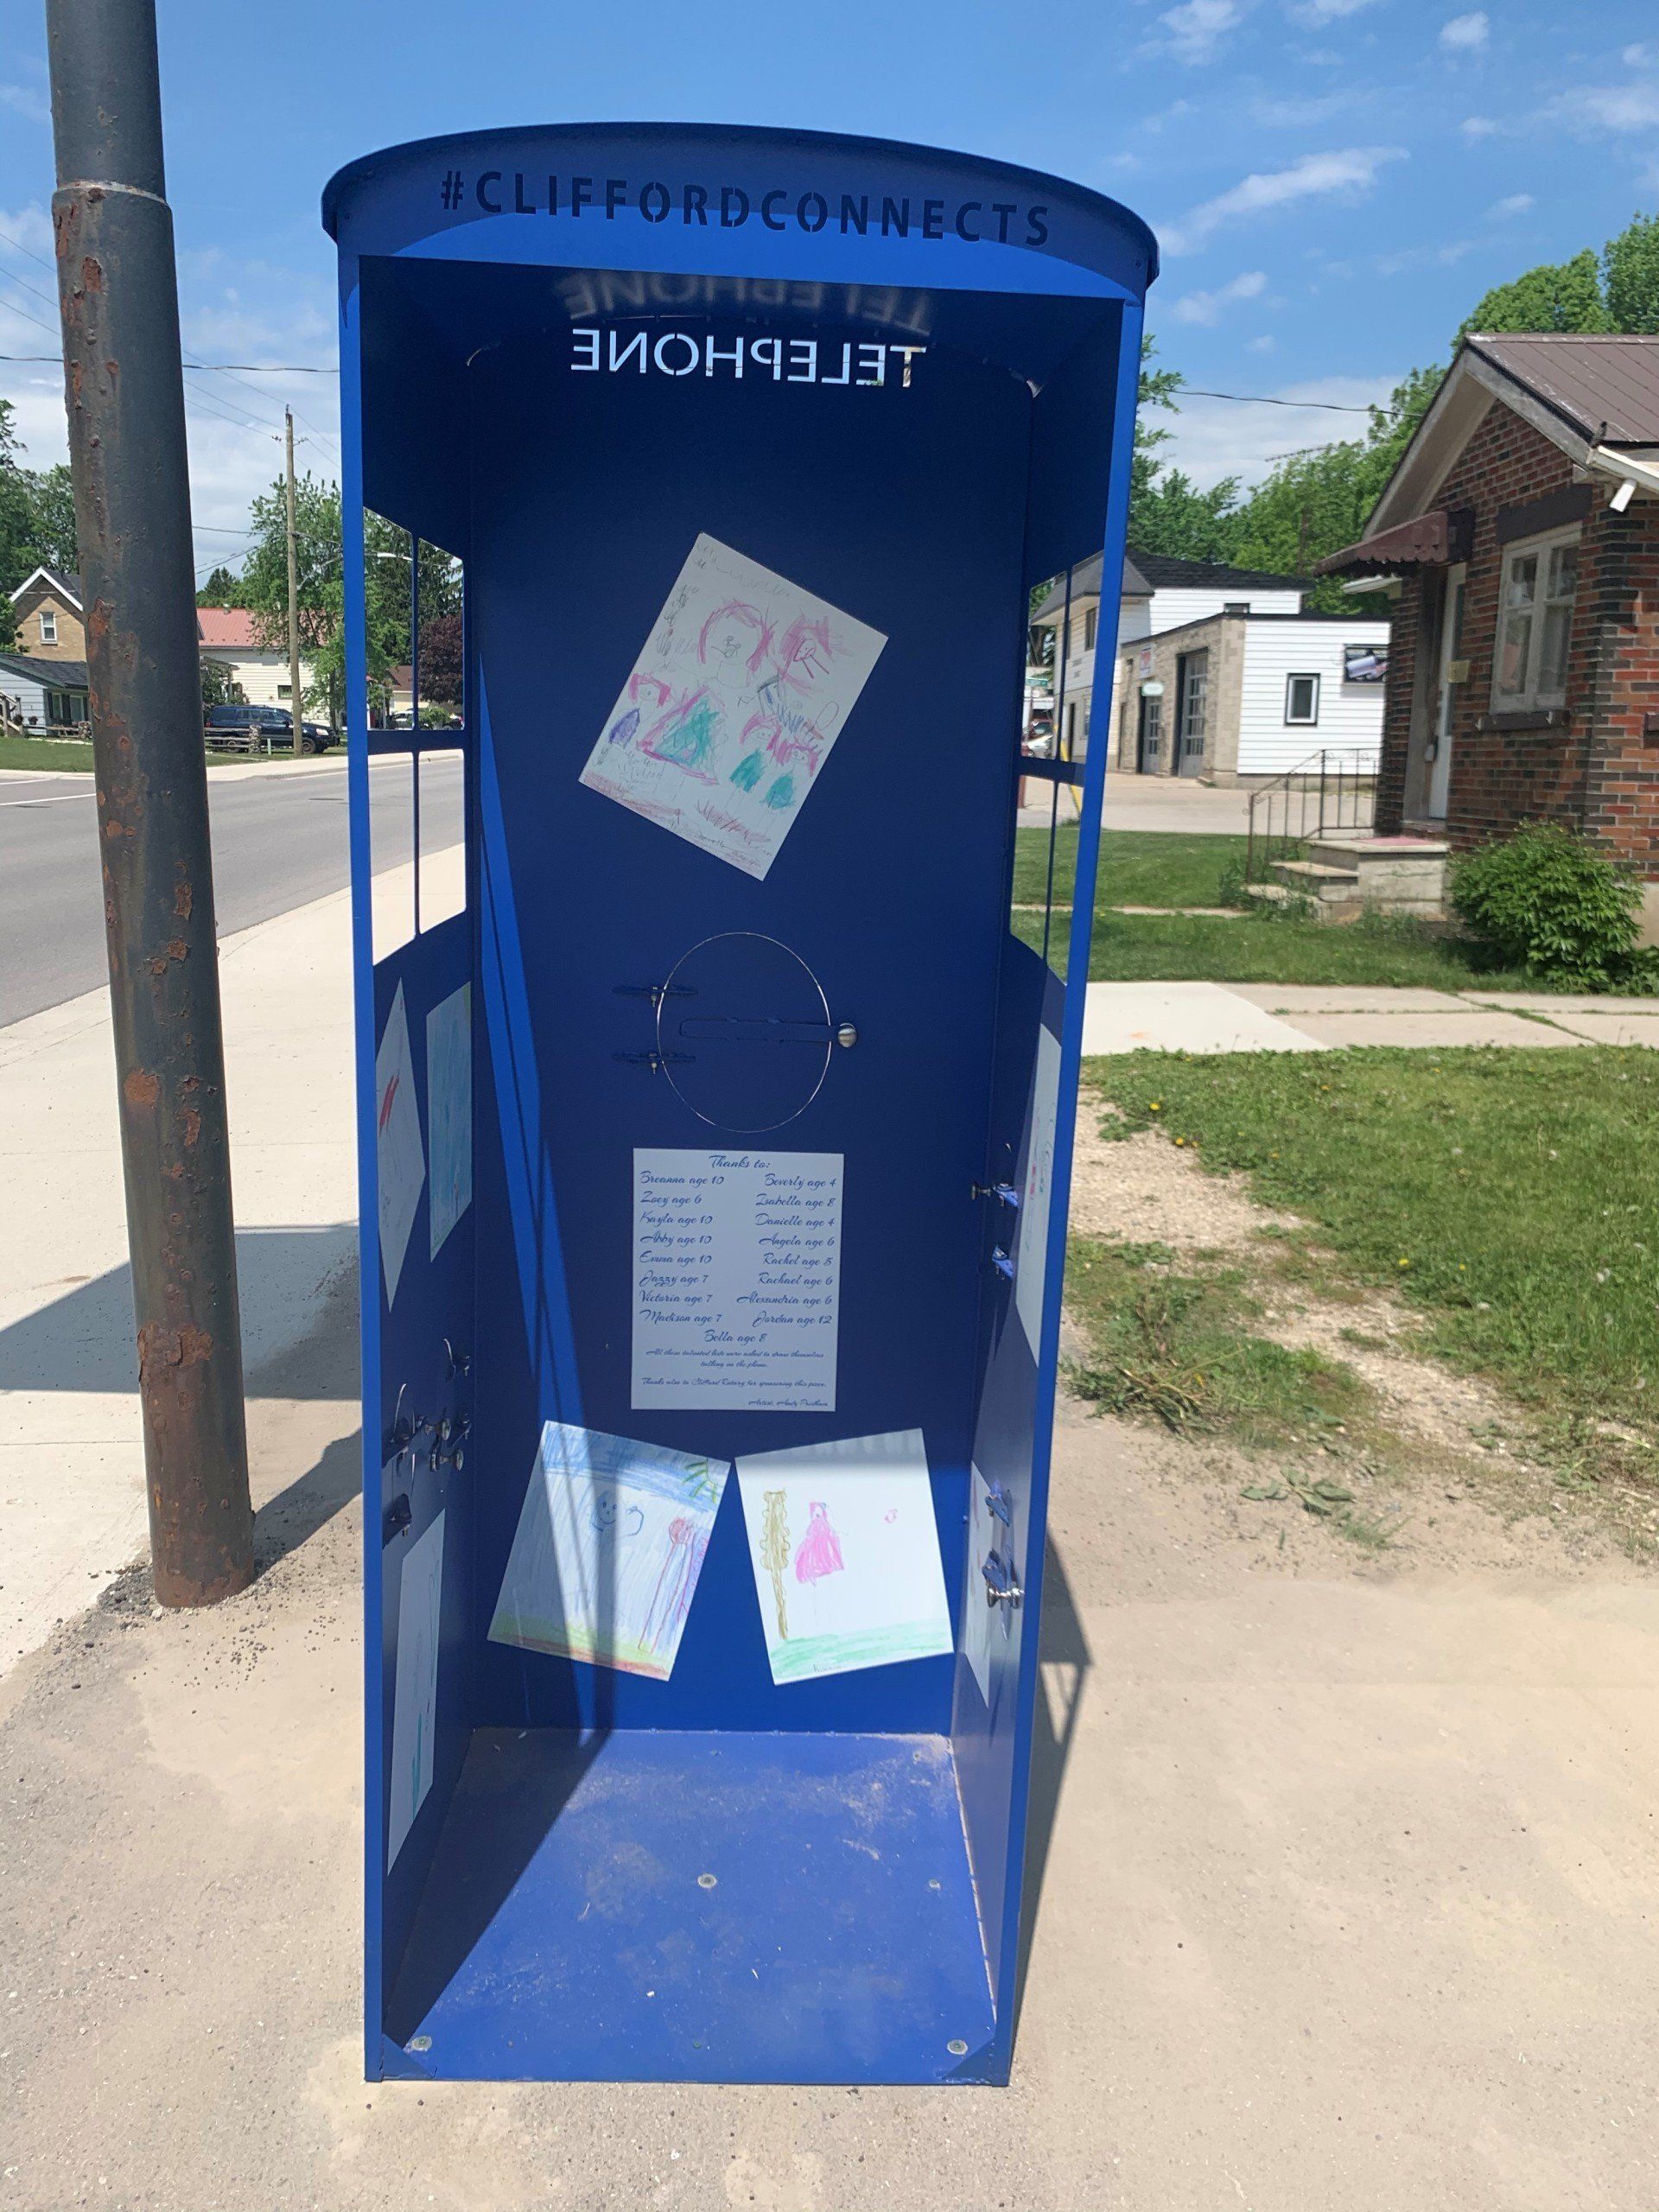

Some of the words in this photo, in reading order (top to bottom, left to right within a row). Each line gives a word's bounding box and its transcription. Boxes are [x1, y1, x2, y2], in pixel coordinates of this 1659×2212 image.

[441, 170, 1051, 247] #CLIFFORDCONNECTS
[708, 1155, 750, 1168] Thanks
[753, 1159, 770, 1168] to:
[640, 1171, 685, 1184] Breanna
[689, 1177, 708, 1188] age
[711, 1176, 724, 1185] 10
[765, 1173, 804, 1189] Beverly
[807, 1179, 826, 1191] age
[830, 1179, 836, 1188] 4
[640, 1191, 670, 1207] Zoey
[671, 1197, 691, 1208] age
[694, 1194, 702, 1204] 6
[755, 1193, 803, 1206] Isabella
[805, 1199, 824, 1211] age
[827, 1198, 836, 1207] 8
[639, 1211, 675, 1227] Kayla
[677, 1217, 697, 1228] age
[700, 1216, 713, 1224] 10
[754, 1213, 803, 1226] Danielle
[805, 1219, 825, 1232] age
[828, 1217, 835, 1227] 4
[640, 1230, 675, 1248] Abby
[677, 1236, 696, 1249] age
[699, 1236, 712, 1244] 10
[759, 1233, 802, 1249] Angela
[805, 1240, 824, 1251] age
[827, 1237, 836, 1246] 6
[639, 1250, 675, 1263] Emma
[677, 1256, 696, 1268] age
[699, 1255, 712, 1264] 10
[763, 1252, 800, 1266] Rachel
[802, 1259, 821, 1270] age
[823, 1257, 834, 1266] 5
[639, 1270, 677, 1287] Jazzy
[680, 1274, 700, 1286] age
[702, 1274, 709, 1284] 7
[759, 1272, 801, 1286] Rachael
[804, 1277, 823, 1289] age
[825, 1277, 833, 1286] 6
[639, 1290, 681, 1303] Victoria
[684, 1295, 703, 1305] age
[706, 1294, 713, 1303] 7
[736, 1291, 800, 1306] Alexandria
[803, 1298, 821, 1308] age
[824, 1296, 833, 1306] 6
[639, 1309, 691, 1325] Madison
[694, 1314, 713, 1326] age
[715, 1313, 723, 1323] 7
[753, 1310, 793, 1327] Jordan
[797, 1317, 816, 1329] age
[818, 1315, 832, 1325] 12
[704, 1329, 734, 1343] Bella
[737, 1334, 756, 1346] age
[759, 1332, 767, 1342] 8
